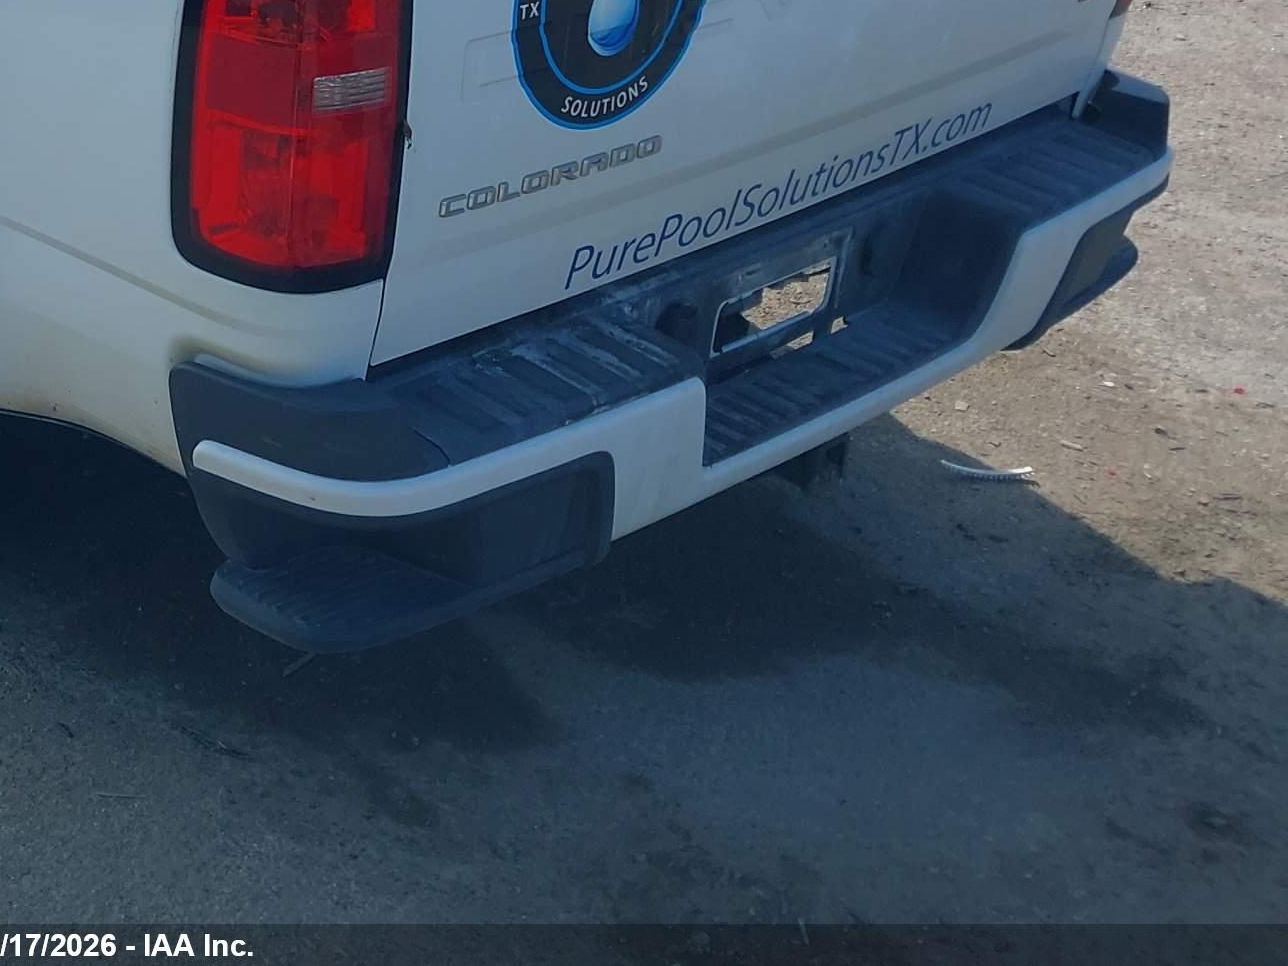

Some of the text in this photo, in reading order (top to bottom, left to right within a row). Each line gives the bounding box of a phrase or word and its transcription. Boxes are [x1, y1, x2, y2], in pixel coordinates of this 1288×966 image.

[519, 1, 540, 20] TX
[560, 75, 649, 117] SOLUTIONS
[438, 134, 663, 218] COLORADO
[565, 102, 994, 291] PurePoolSolutionsTX.com
